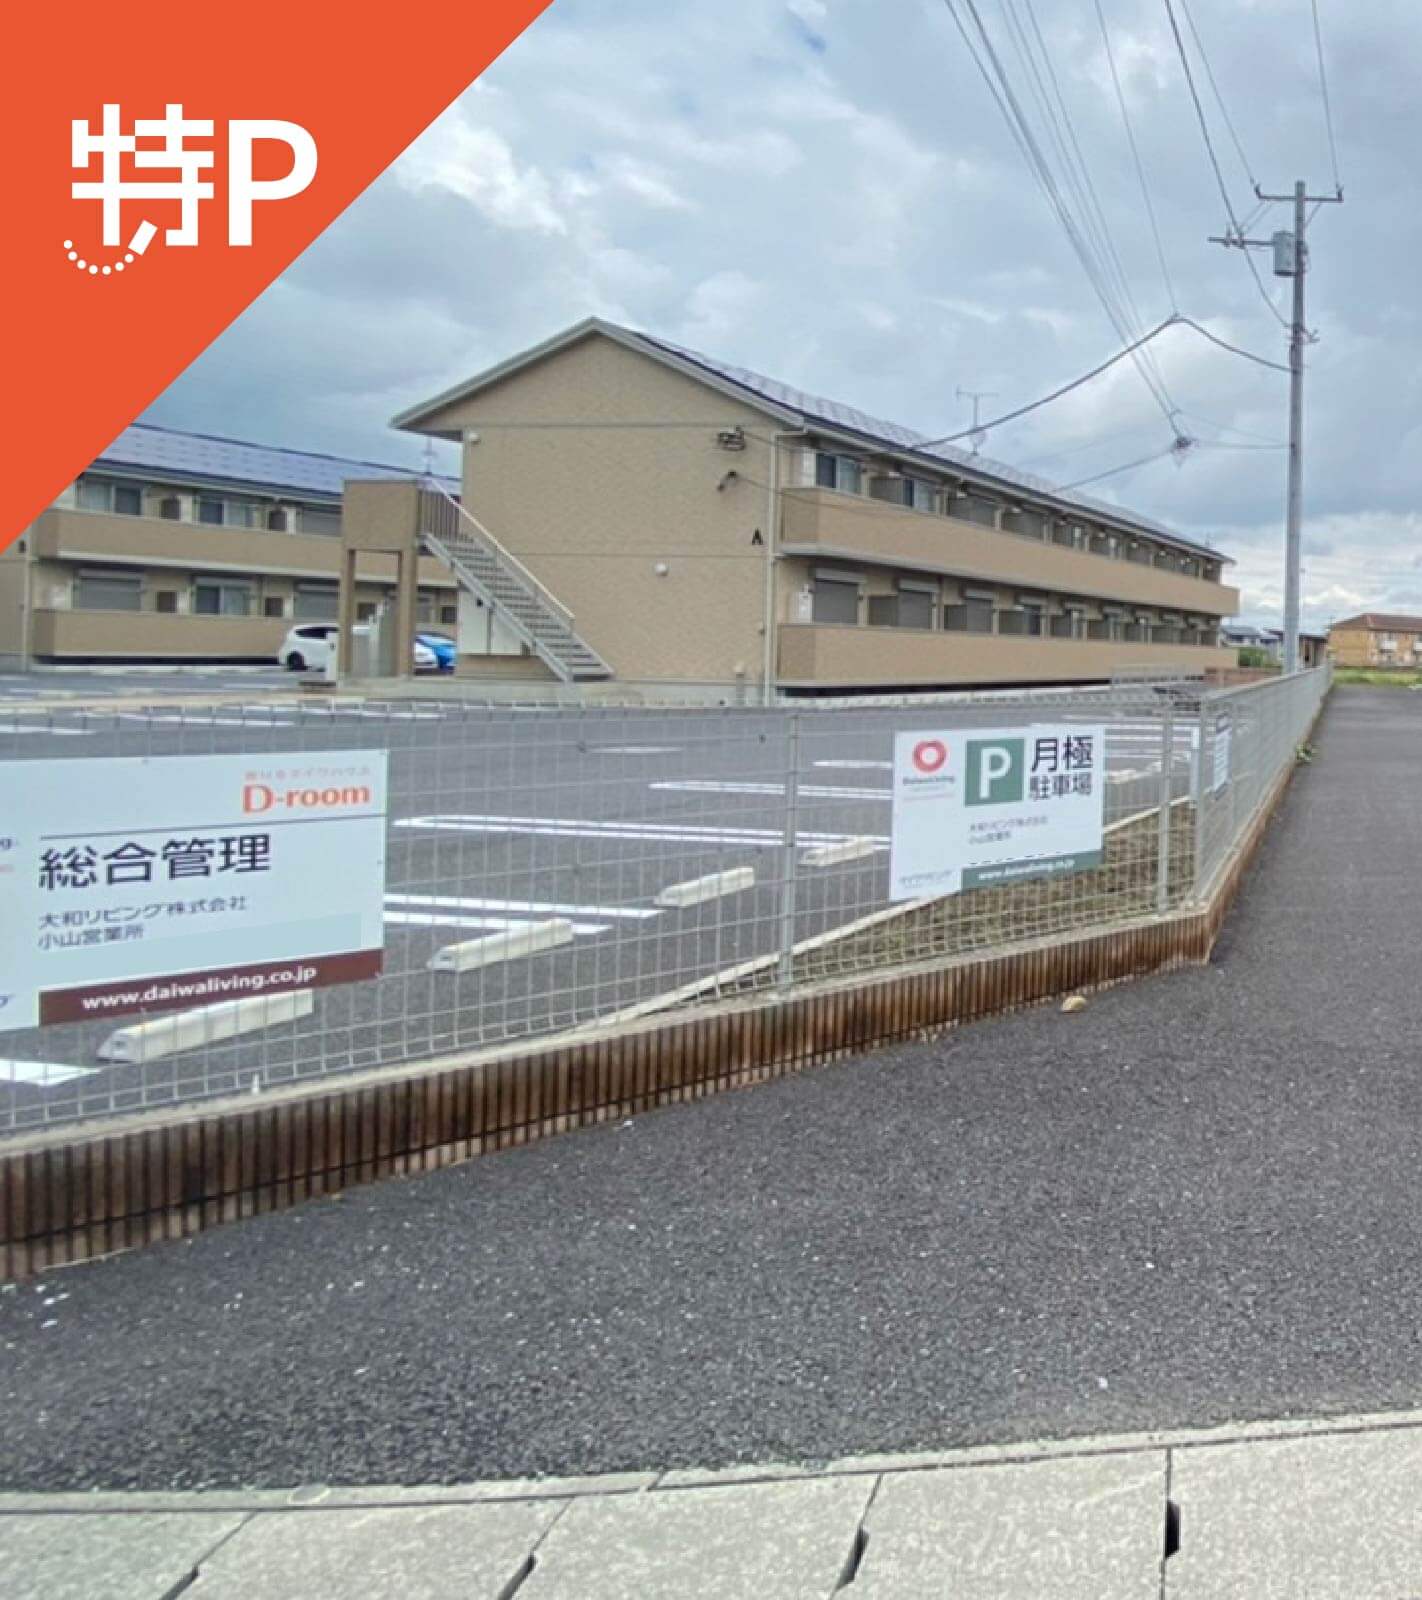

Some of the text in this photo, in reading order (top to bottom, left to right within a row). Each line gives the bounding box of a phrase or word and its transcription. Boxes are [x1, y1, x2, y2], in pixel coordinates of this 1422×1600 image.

[751, 527, 763, 546] A
[1031, 734, 1094, 773] 月極
[979, 747, 1011, 799] P
[1029, 772, 1092, 801] 駐車場
[242, 783, 371, 813] D-room
[38, 832, 270, 891] 総合管理
[38, 895, 247, 930] 大和リビング株式会社
[81, 965, 318, 1010] www.daiwaliving.co.jp
